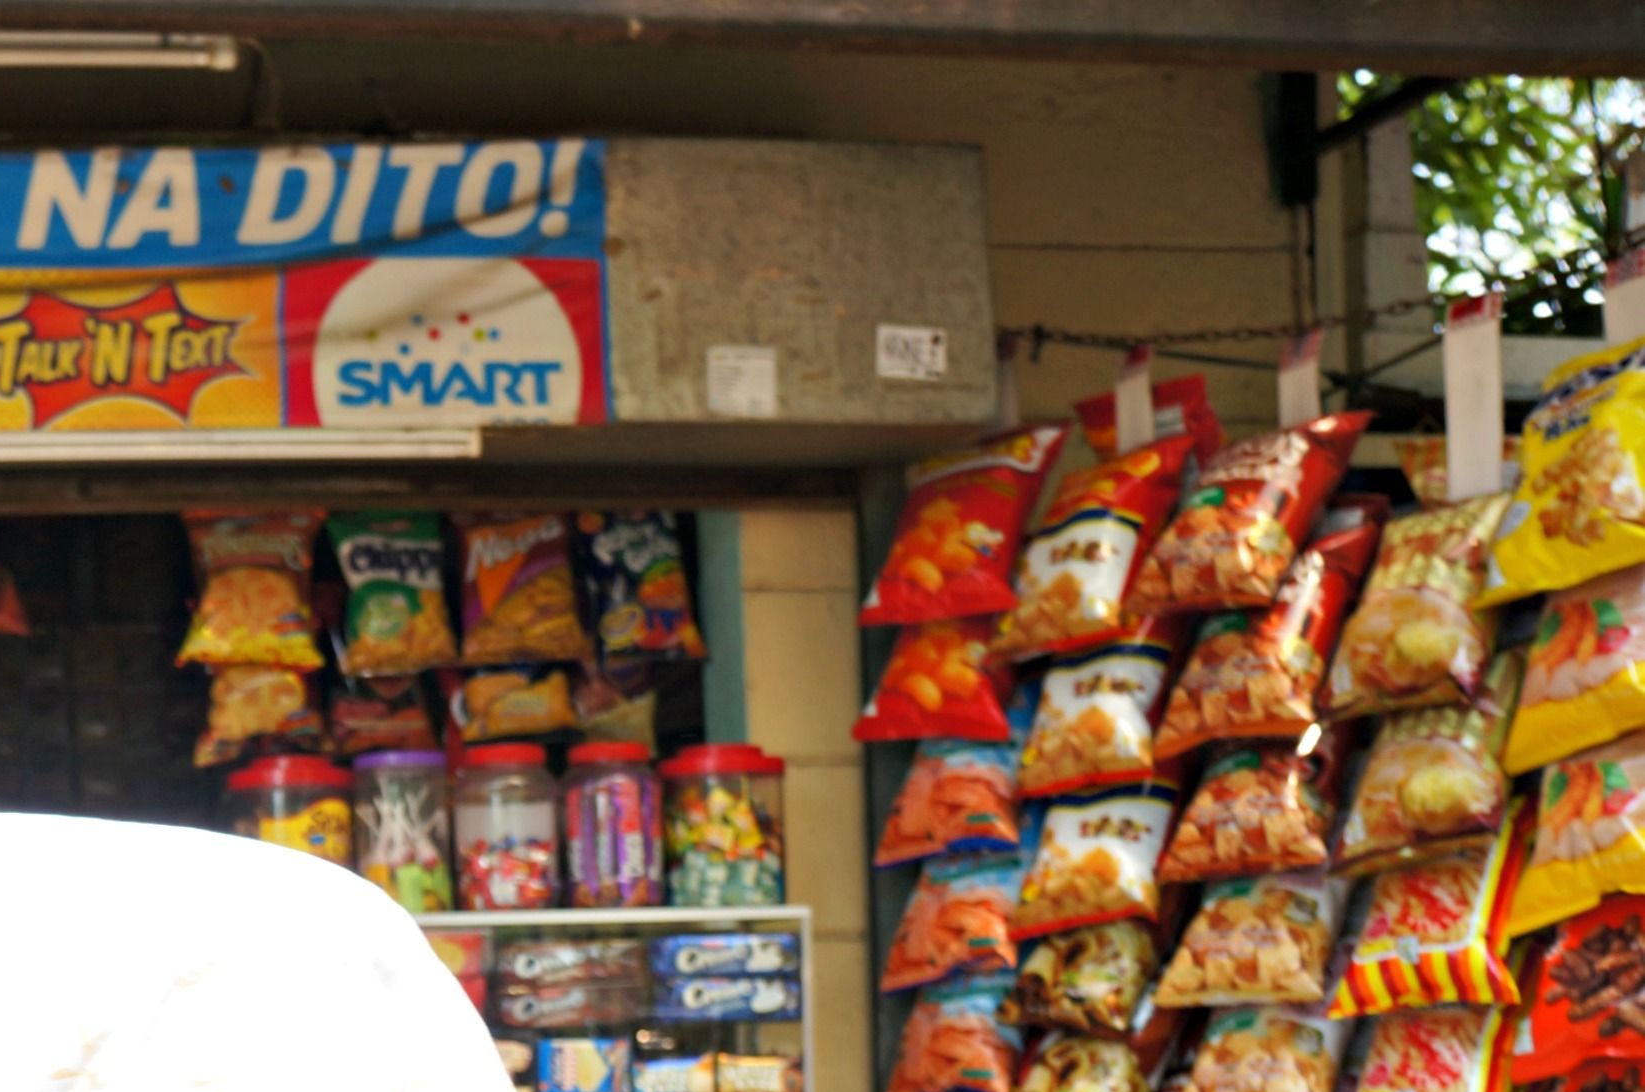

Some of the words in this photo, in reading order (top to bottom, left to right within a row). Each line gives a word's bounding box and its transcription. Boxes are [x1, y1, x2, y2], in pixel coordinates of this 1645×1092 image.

[16, 147, 201, 250] NA
[235, 138, 585, 246] DITO!
[336, 359, 561, 407] SMART
